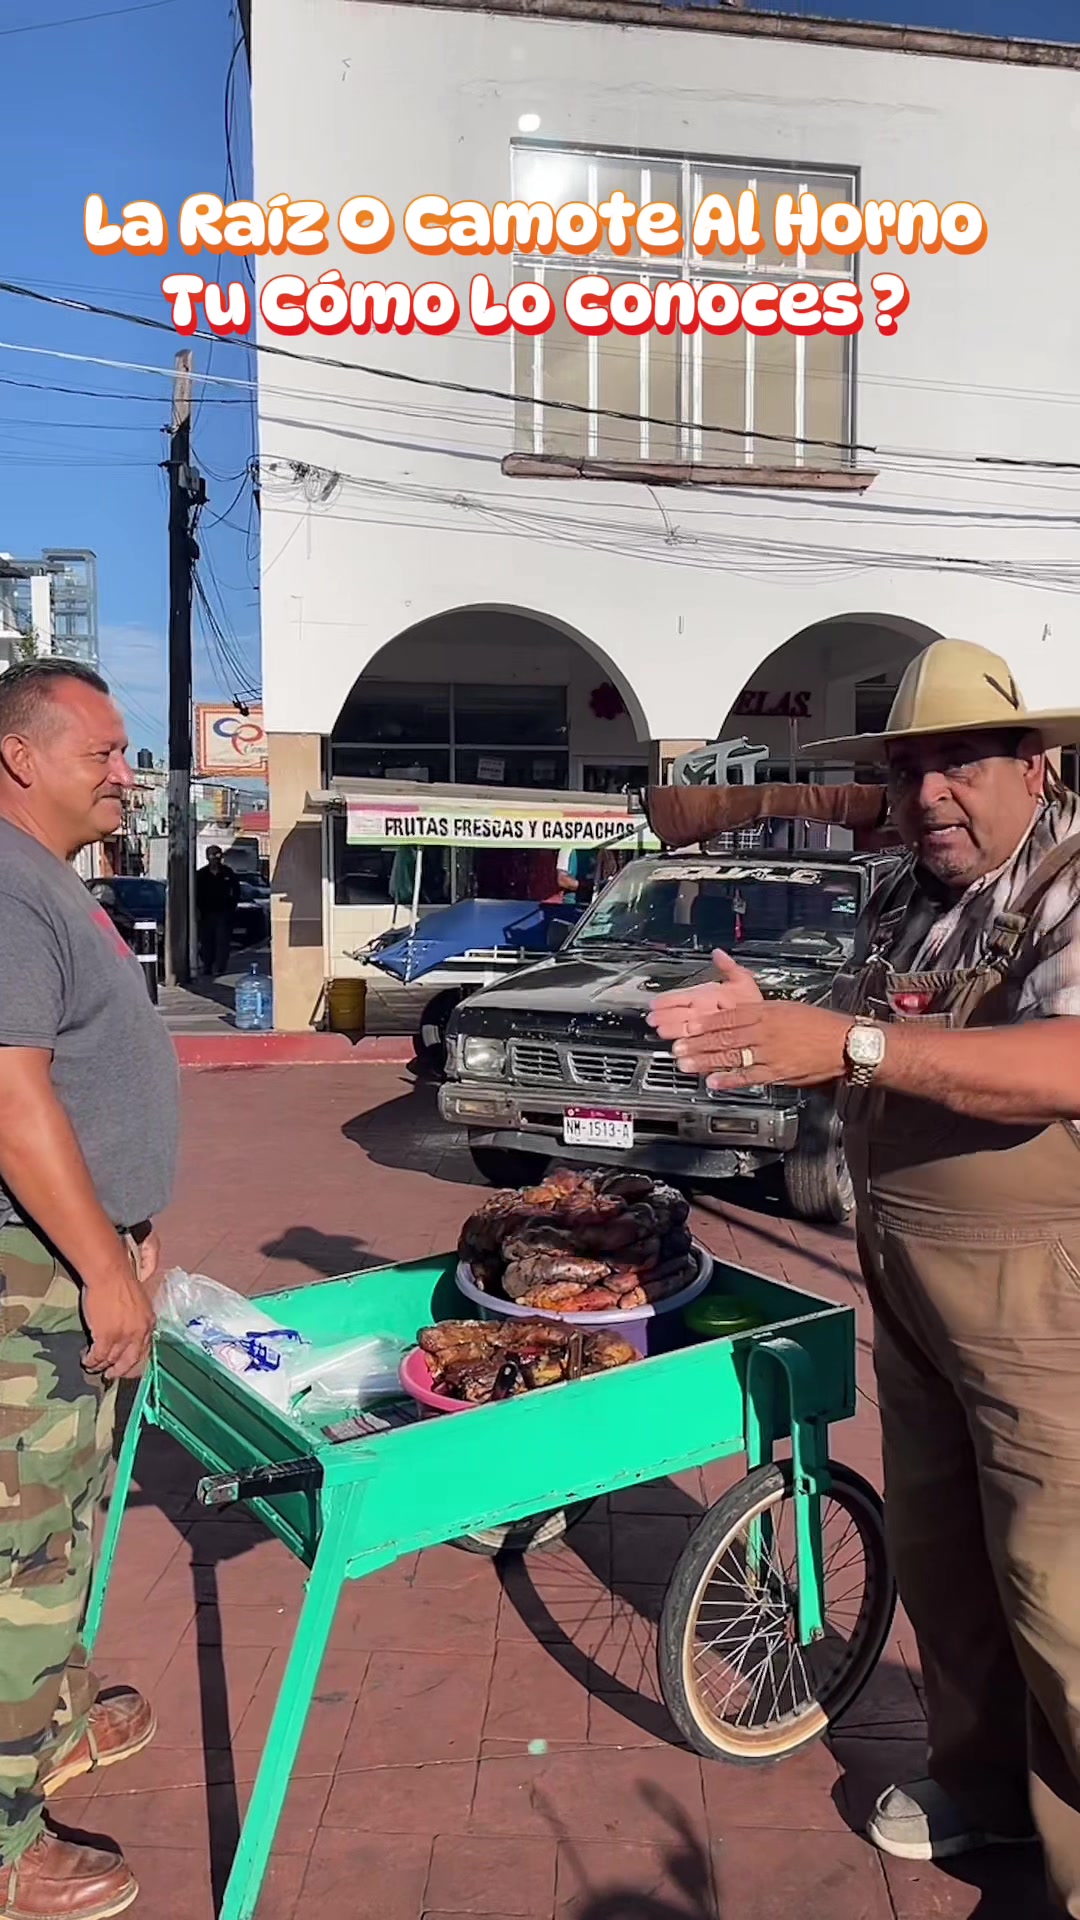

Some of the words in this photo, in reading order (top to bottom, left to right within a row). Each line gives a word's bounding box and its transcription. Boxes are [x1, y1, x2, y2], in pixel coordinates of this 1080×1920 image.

[384, 816, 449, 837] FRUTAS
[453, 818, 525, 839] FRESCAS
[529, 821, 537, 839] Y
[541, 822, 635, 841] GASPACHOS
[566, 1120, 630, 1138] NM-1513-A
